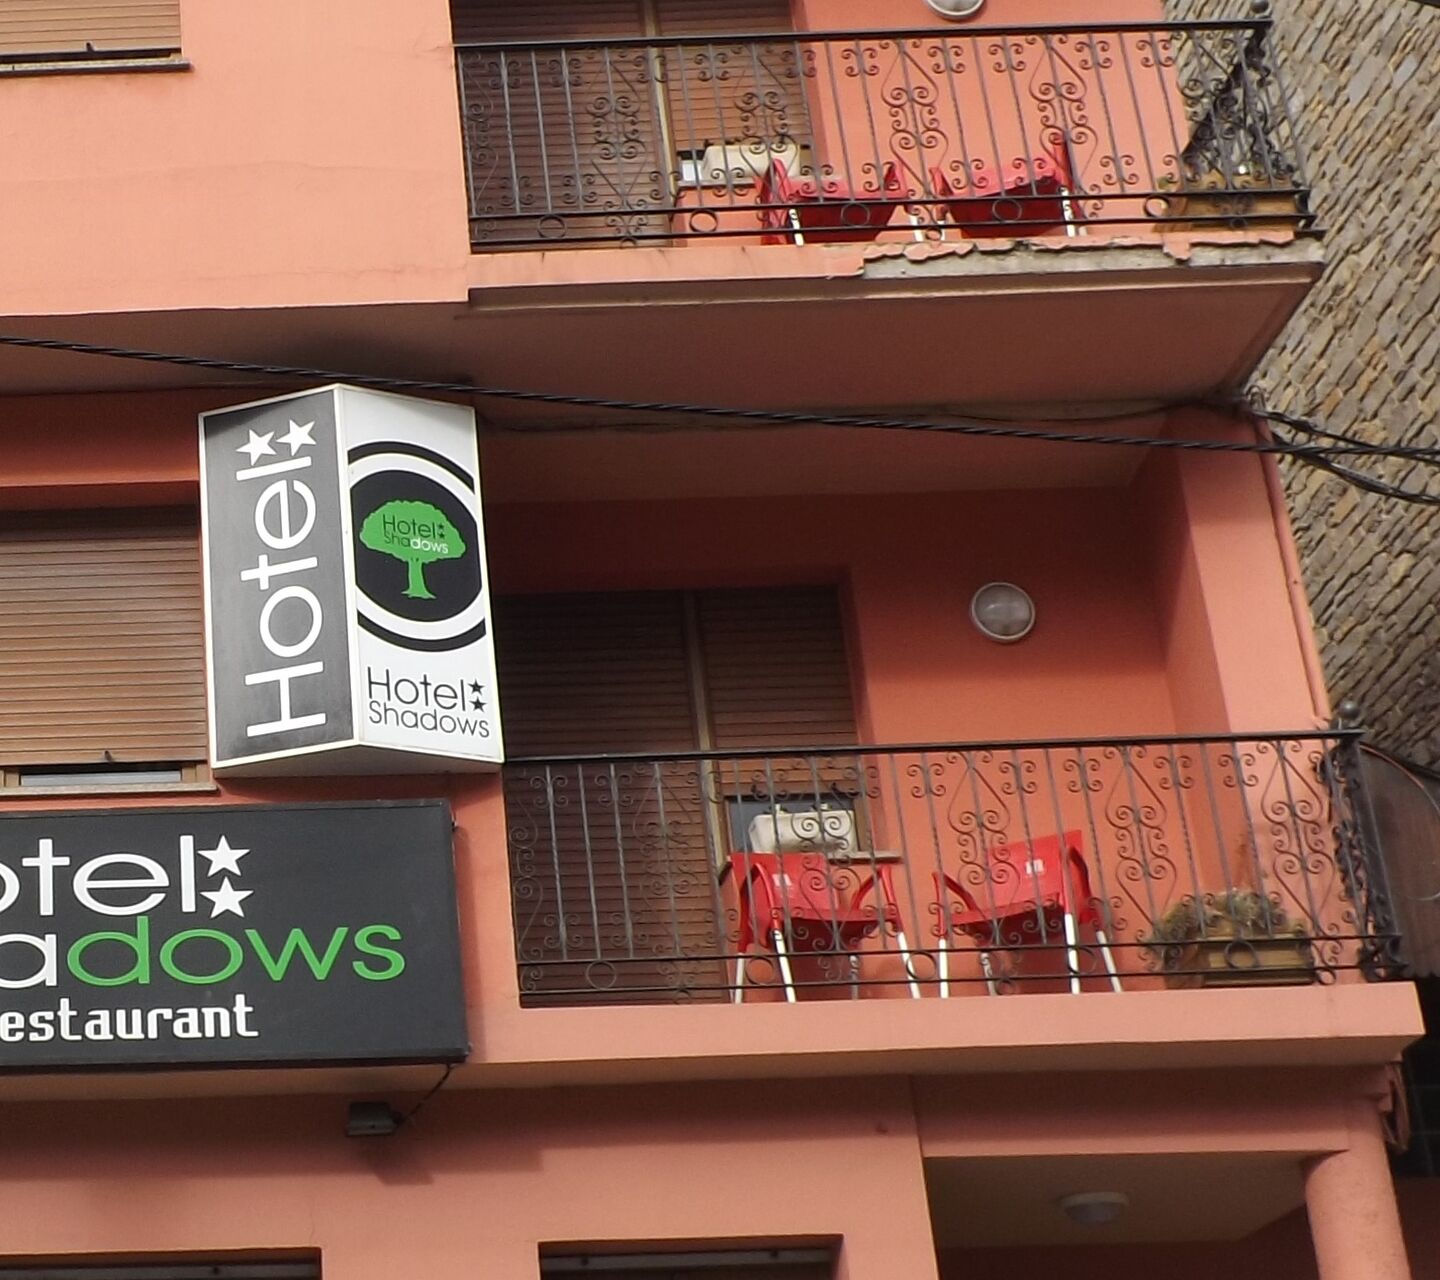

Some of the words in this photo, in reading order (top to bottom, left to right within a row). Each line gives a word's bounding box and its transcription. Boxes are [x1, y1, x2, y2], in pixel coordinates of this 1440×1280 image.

[382, 514, 437, 539] Hotel
[384, 531, 449, 555] Shadows
[235, 455, 327, 738] Hotel
[367, 666, 466, 712] Hotel
[368, 700, 491, 739] Shadows
